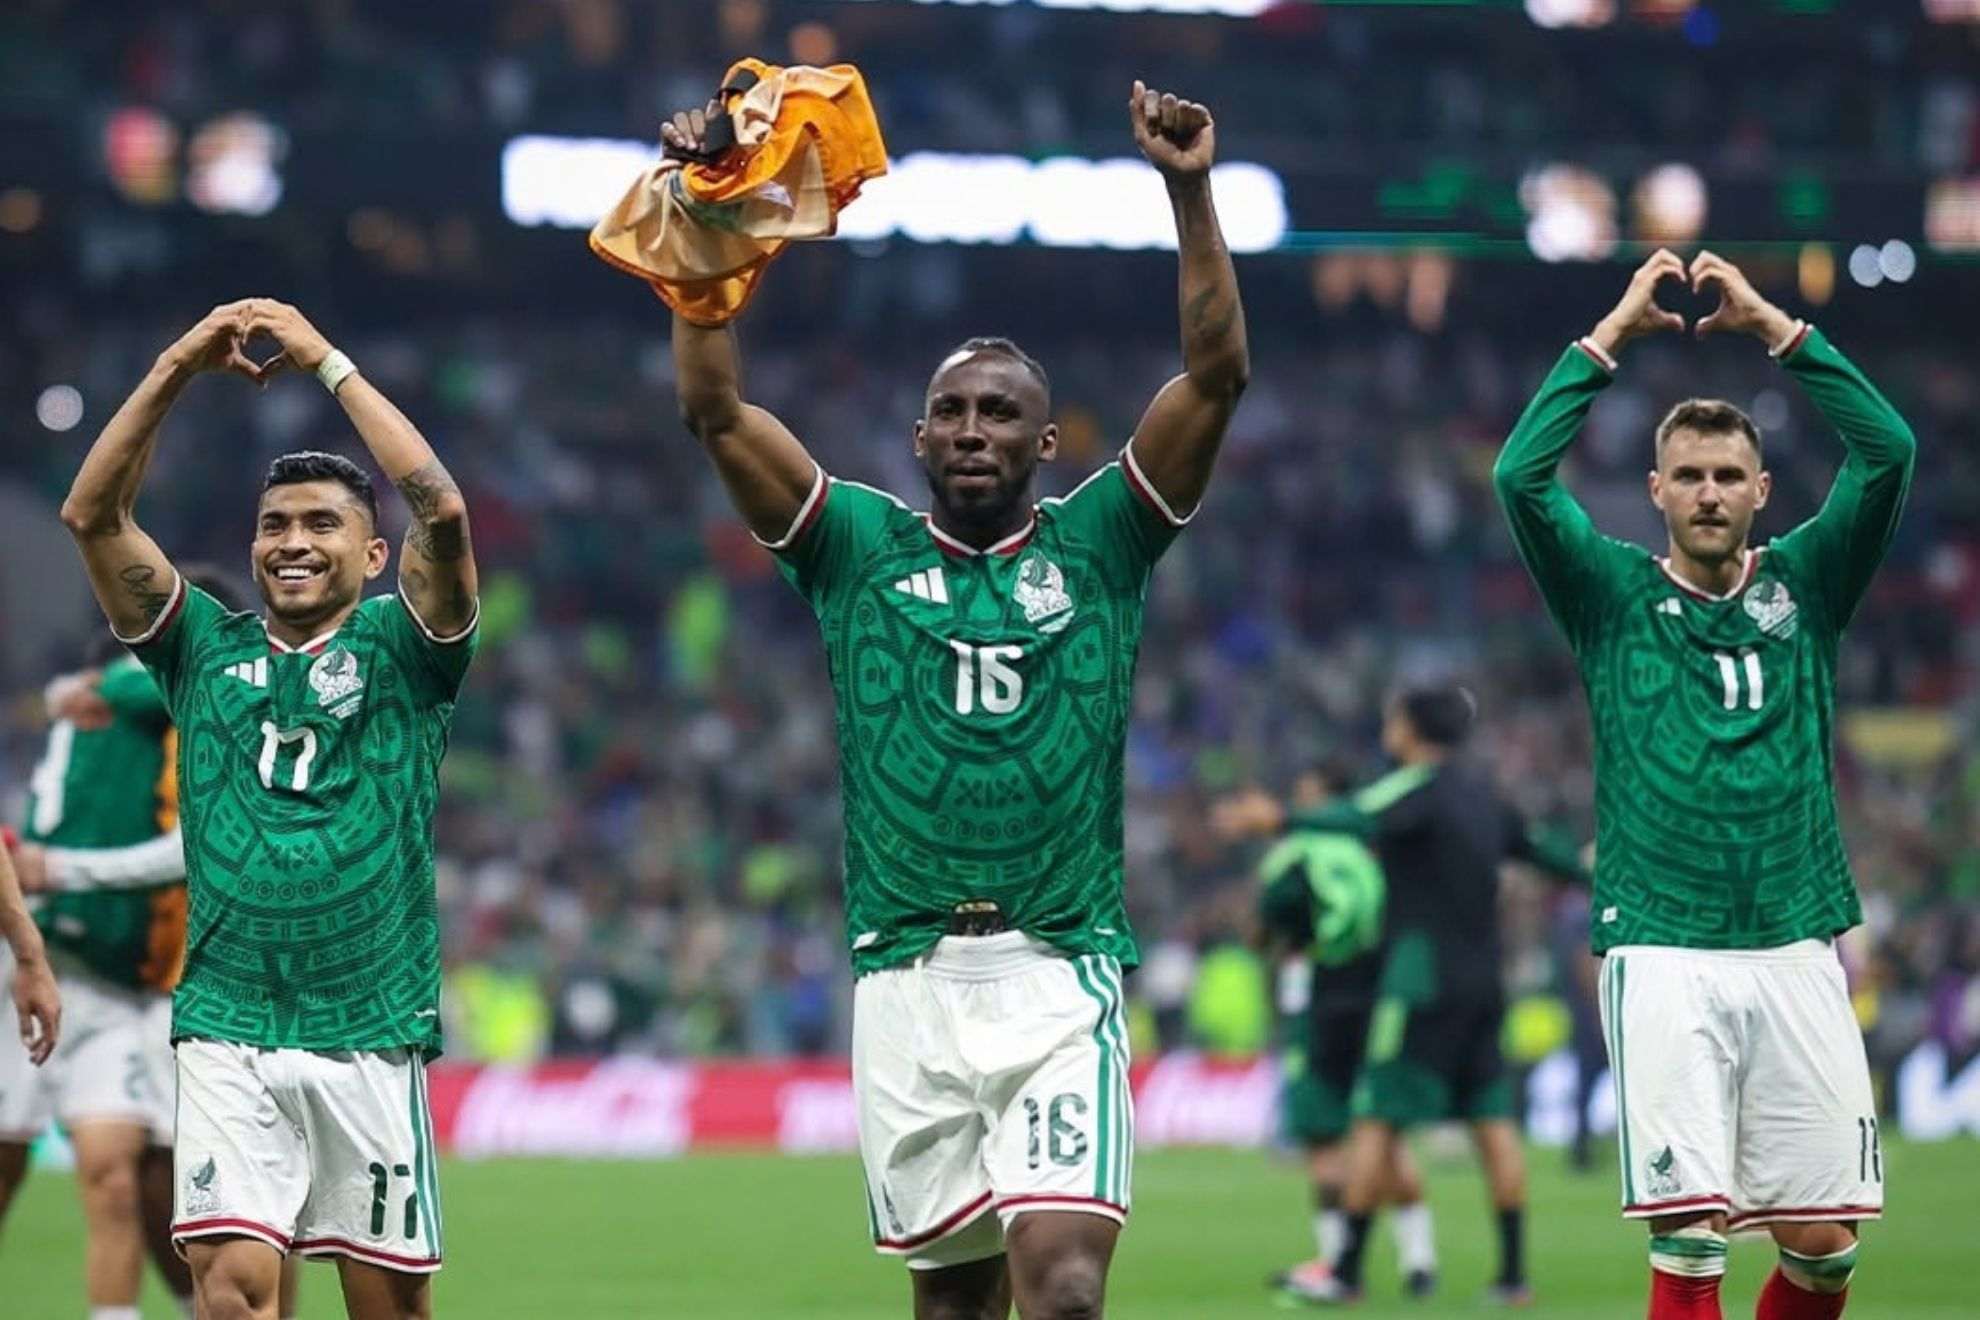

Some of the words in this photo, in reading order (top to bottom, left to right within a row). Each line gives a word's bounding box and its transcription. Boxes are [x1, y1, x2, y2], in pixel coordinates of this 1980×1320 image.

[949, 639, 1023, 715] 16
[1713, 648, 1763, 710] 11
[258, 721, 317, 791] 17
[1024, 1092, 1088, 1170] 16
[1858, 1117, 1881, 1182] 11
[369, 1161, 418, 1239] 17
